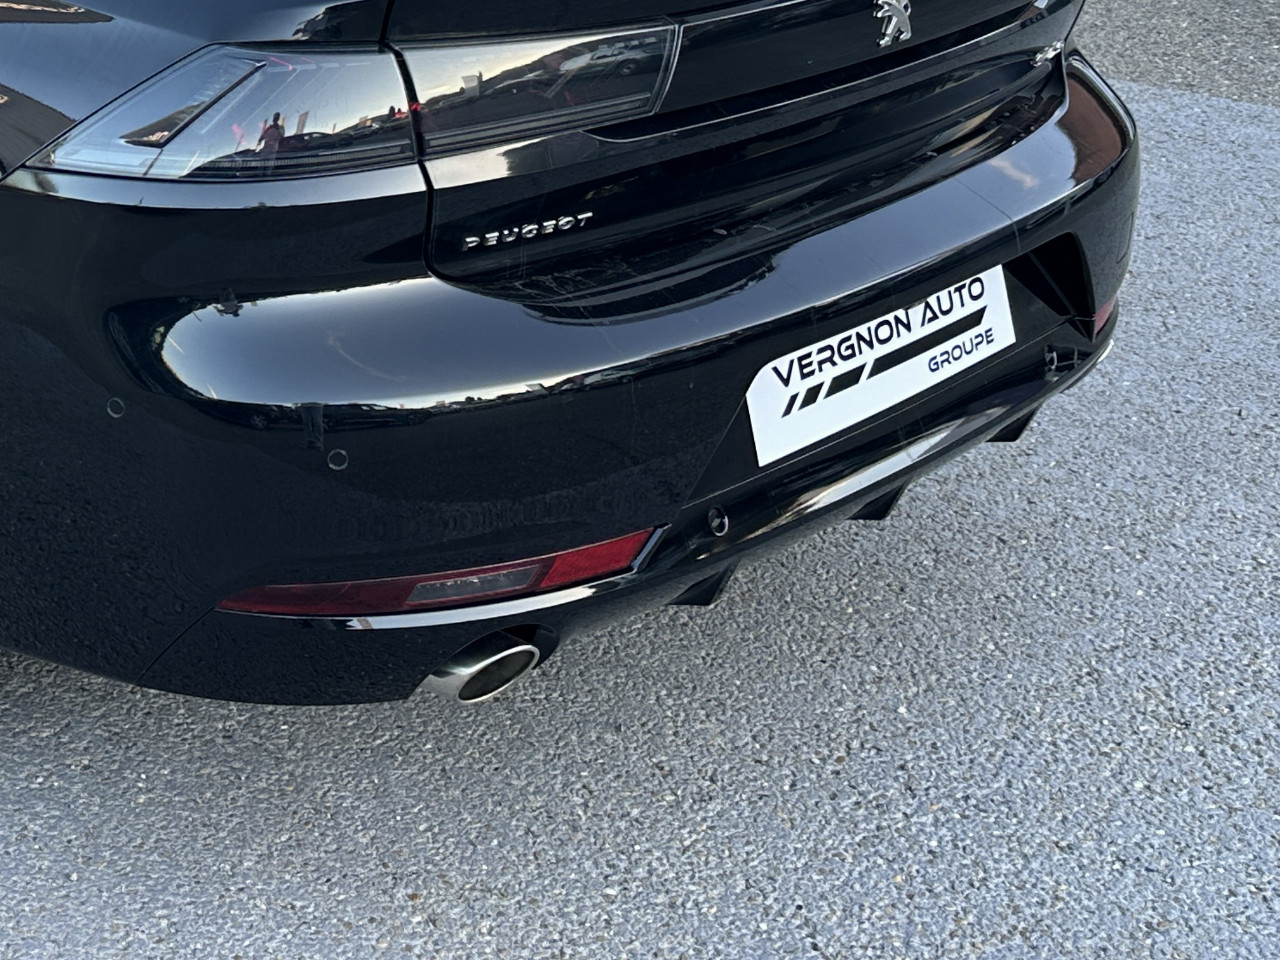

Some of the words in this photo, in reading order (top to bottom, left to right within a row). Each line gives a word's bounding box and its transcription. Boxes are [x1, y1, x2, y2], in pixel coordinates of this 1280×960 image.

[461, 212, 594, 251] PEUGEOT
[771, 309, 912, 388] VERGNON
[920, 276, 985, 327] AUTO
[928, 327, 995, 373] GROUPE
